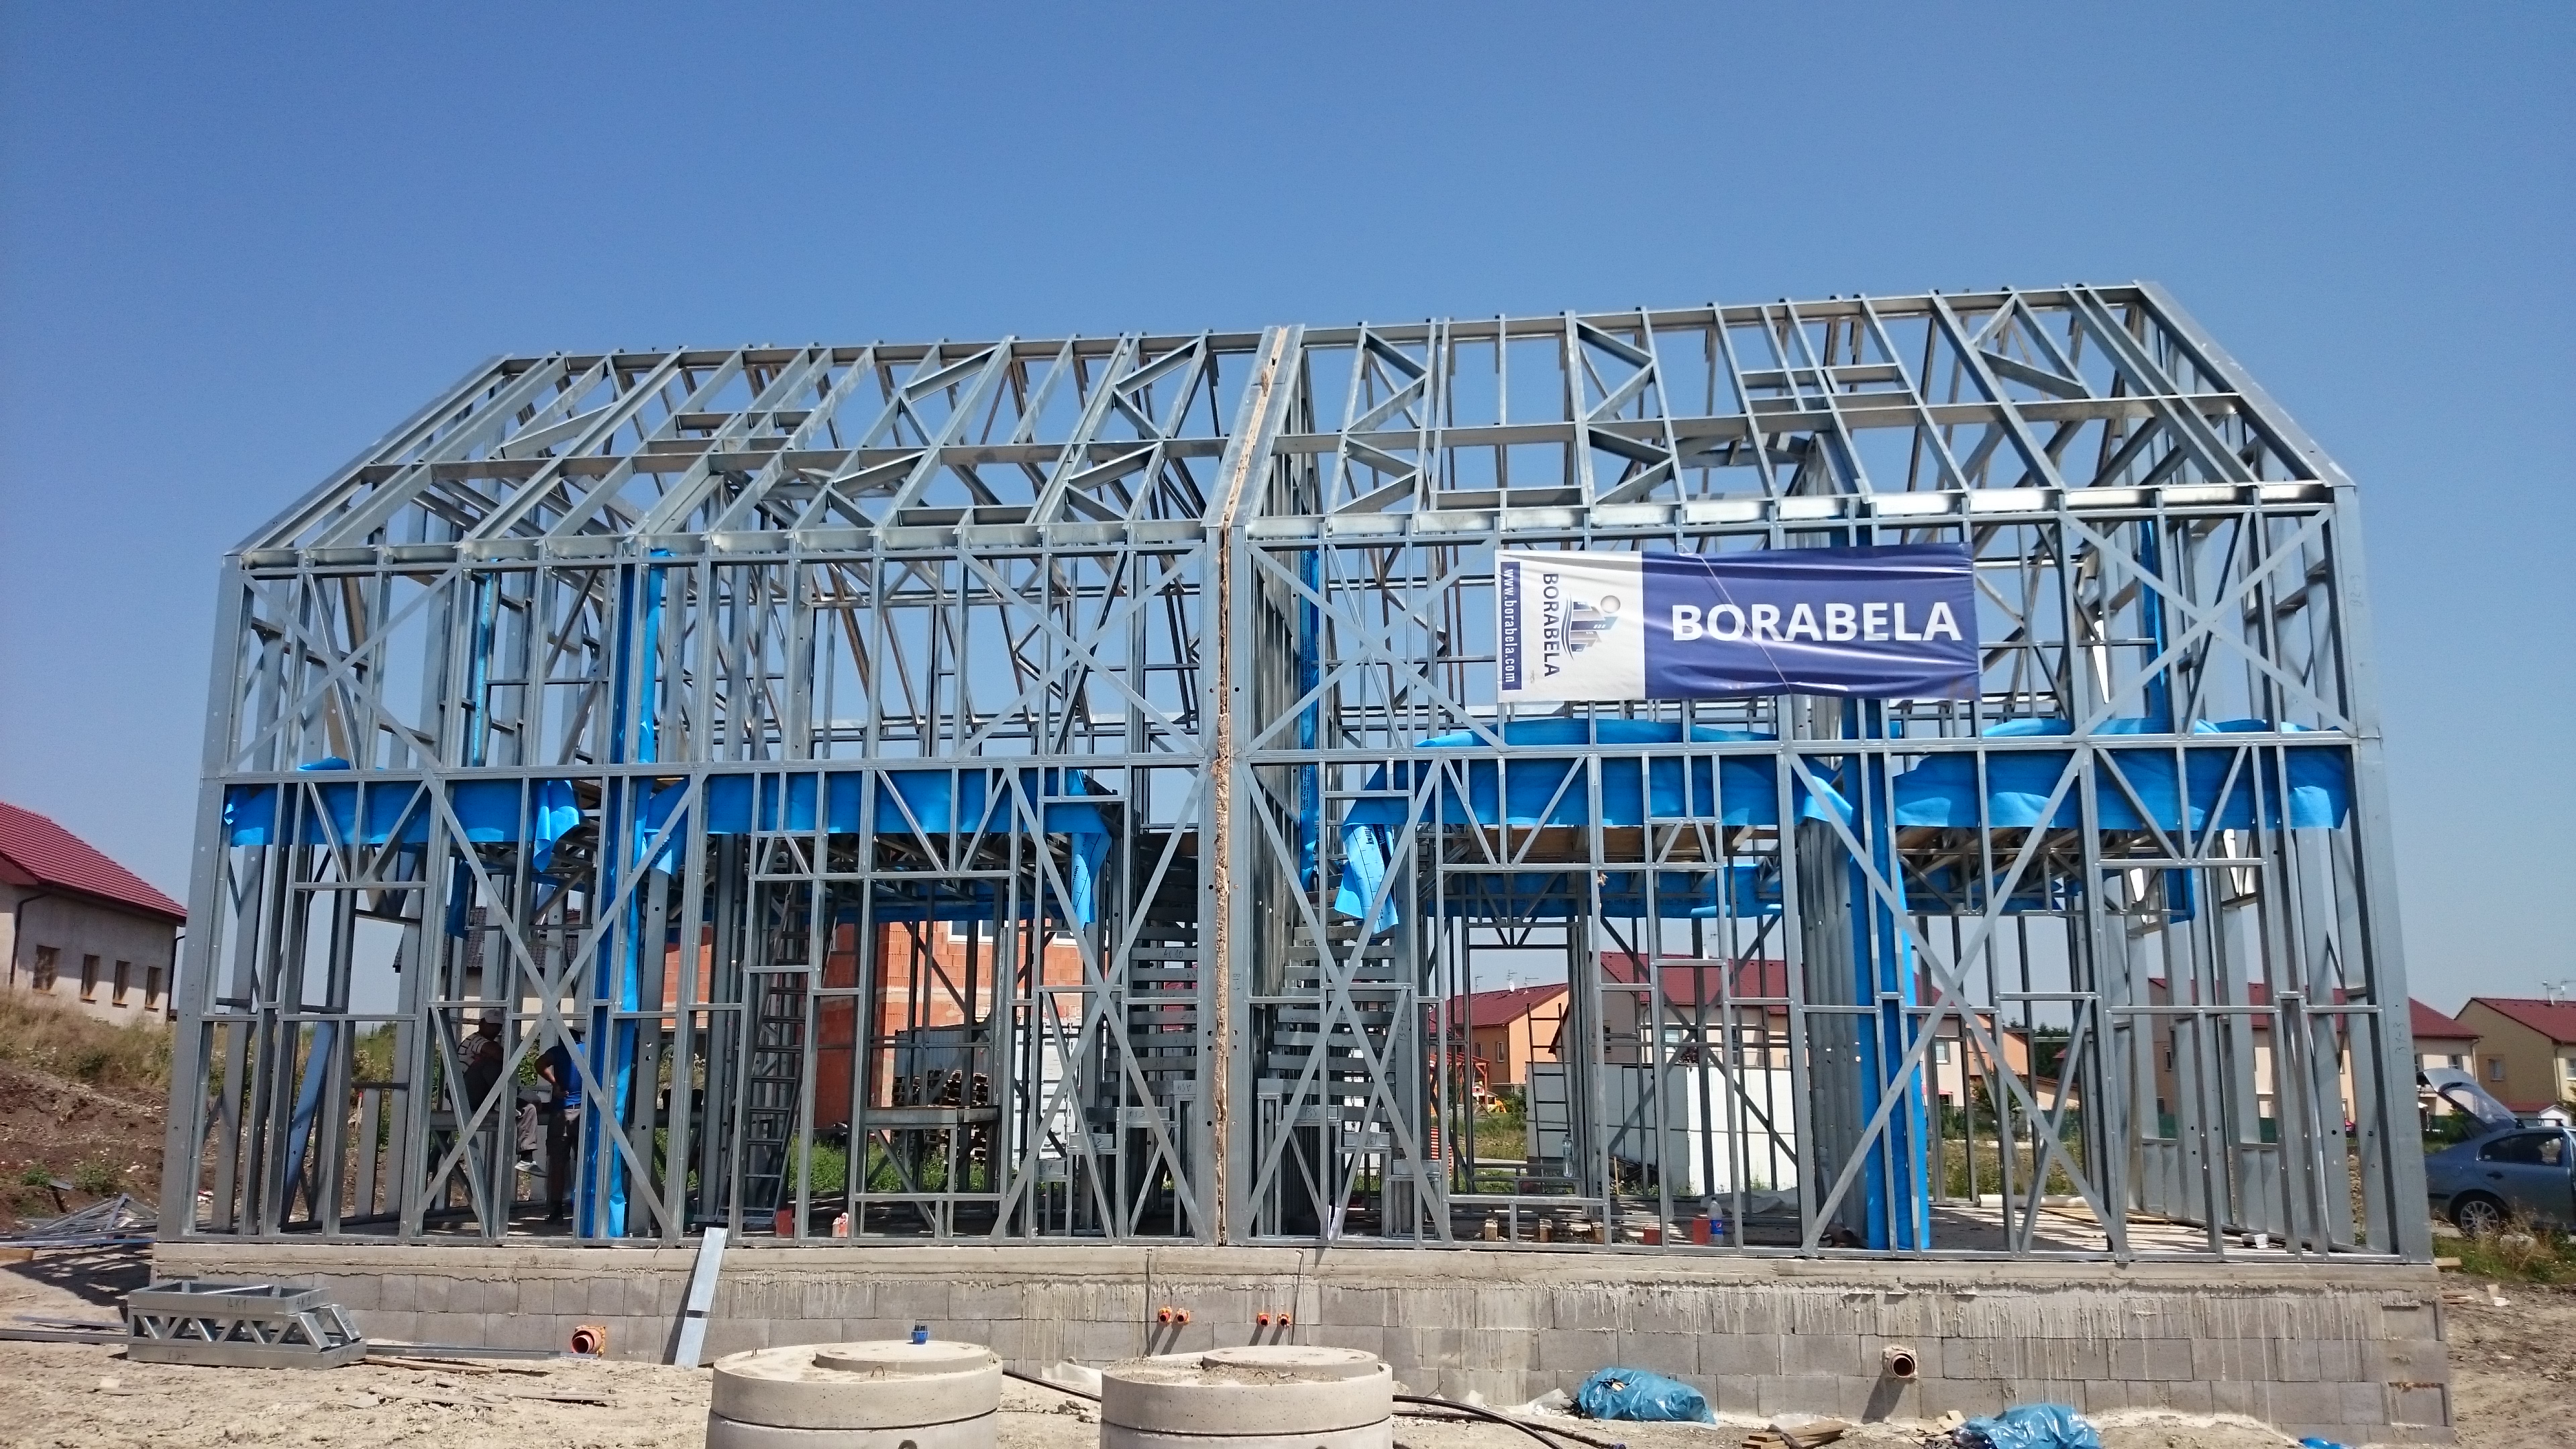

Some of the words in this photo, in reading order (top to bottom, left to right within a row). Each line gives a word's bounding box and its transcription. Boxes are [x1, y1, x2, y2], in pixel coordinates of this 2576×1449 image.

[1503, 569, 1518, 683] www.borabela.com
[1543, 574, 1560, 678] BORABELA
[1672, 602, 1964, 642] BORABELA
